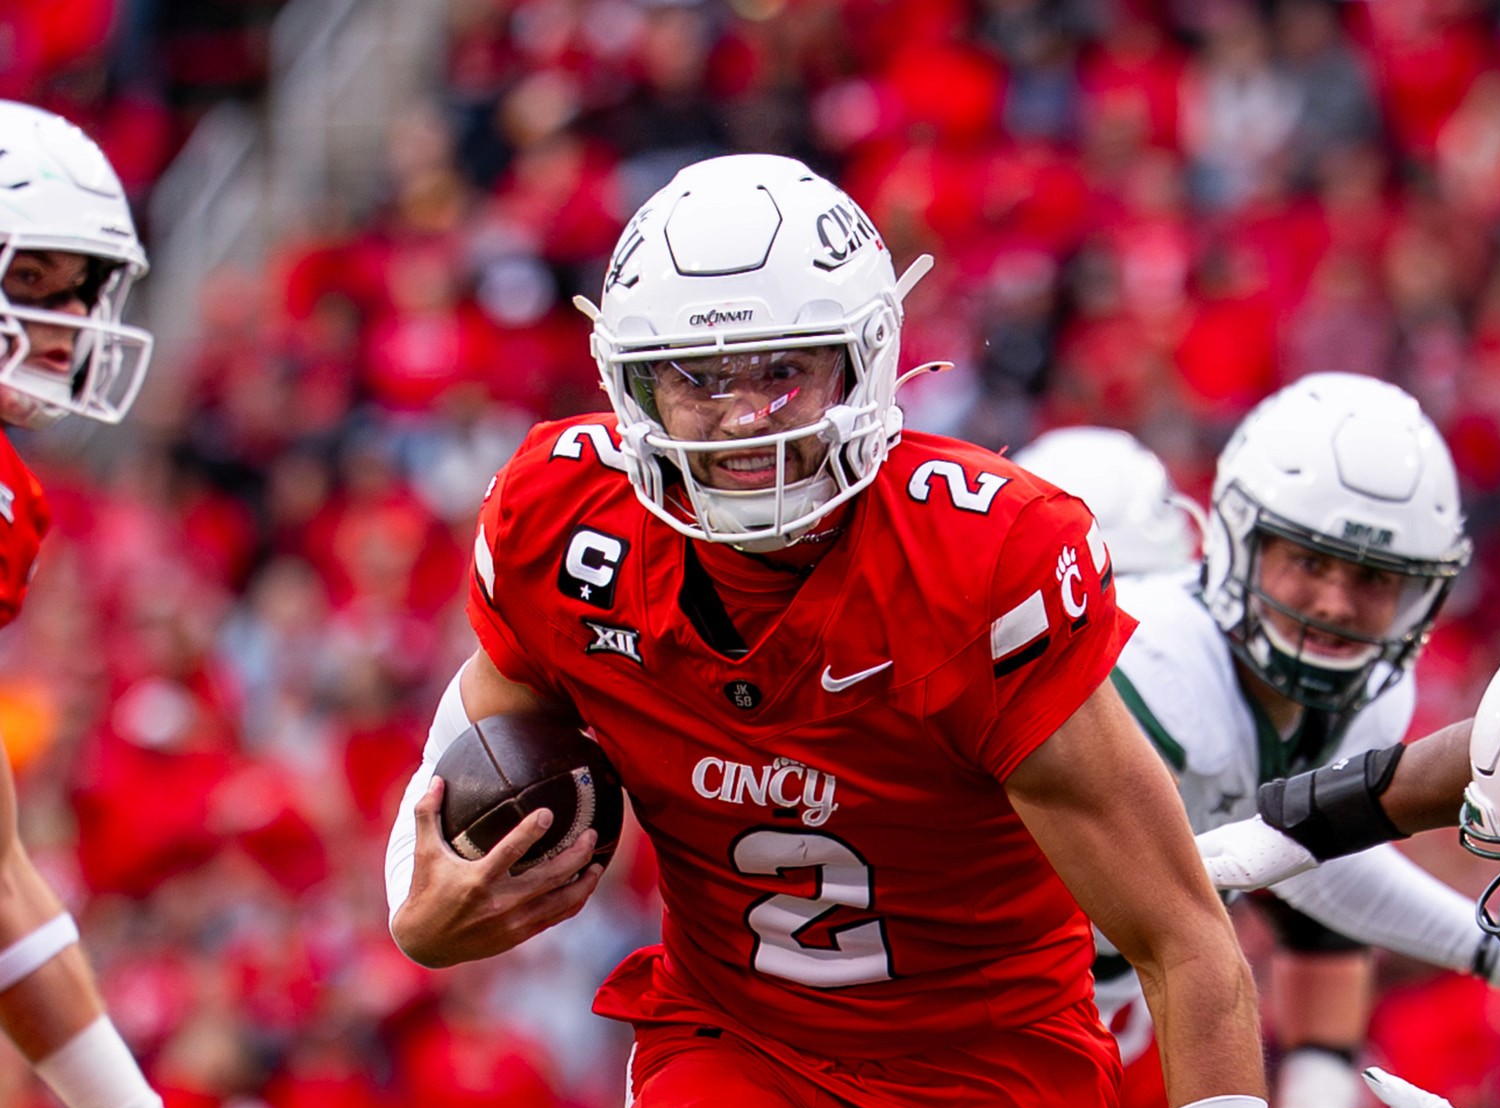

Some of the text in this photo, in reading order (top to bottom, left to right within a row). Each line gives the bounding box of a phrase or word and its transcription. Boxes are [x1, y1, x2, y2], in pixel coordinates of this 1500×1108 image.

[689, 309, 753, 326] CINCINNATI
[549, 423, 632, 474] 2
[907, 459, 1012, 515] 2
[565, 530, 622, 588] C
[1057, 552, 1087, 618] C
[582, 618, 644, 665] XII
[734, 684, 750, 696] JK
[731, 828, 895, 989] 2
